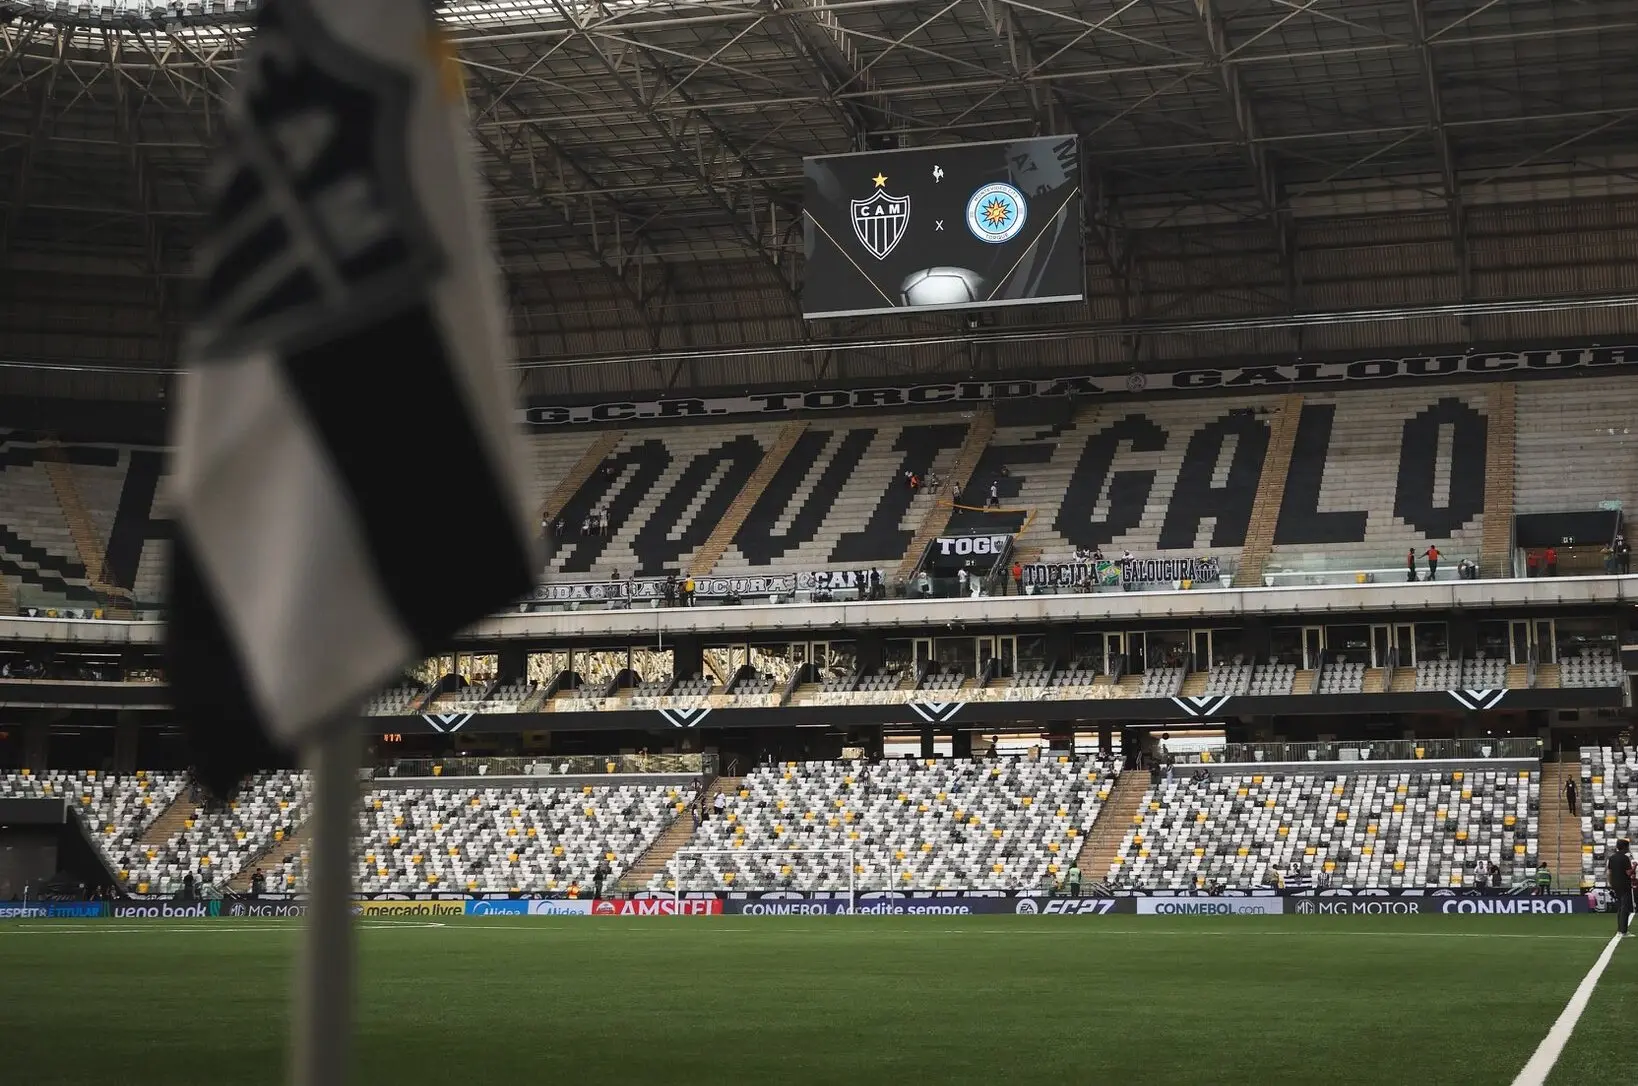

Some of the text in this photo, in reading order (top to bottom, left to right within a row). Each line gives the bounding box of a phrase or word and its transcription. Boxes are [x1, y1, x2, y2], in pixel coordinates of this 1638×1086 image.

[860, 203, 901, 217] CAM
[985, 232, 1009, 240] TORQUE
[749, 376, 1106, 413] TORCIDA
[1172, 345, 1638, 389] GALOUCUR
[1052, 398, 1489, 550] GALO
[1122, 557, 1196, 583] GALOUCURA
[55, 907, 100, 917] TITULAR
[114, 902, 207, 918] ueno bank
[249, 905, 308, 916] MG MOT
[367, 902, 463, 916] mercado livre
[1319, 902, 1419, 914] MG MOTOR
[1442, 899, 1573, 914] CONMEBOL
